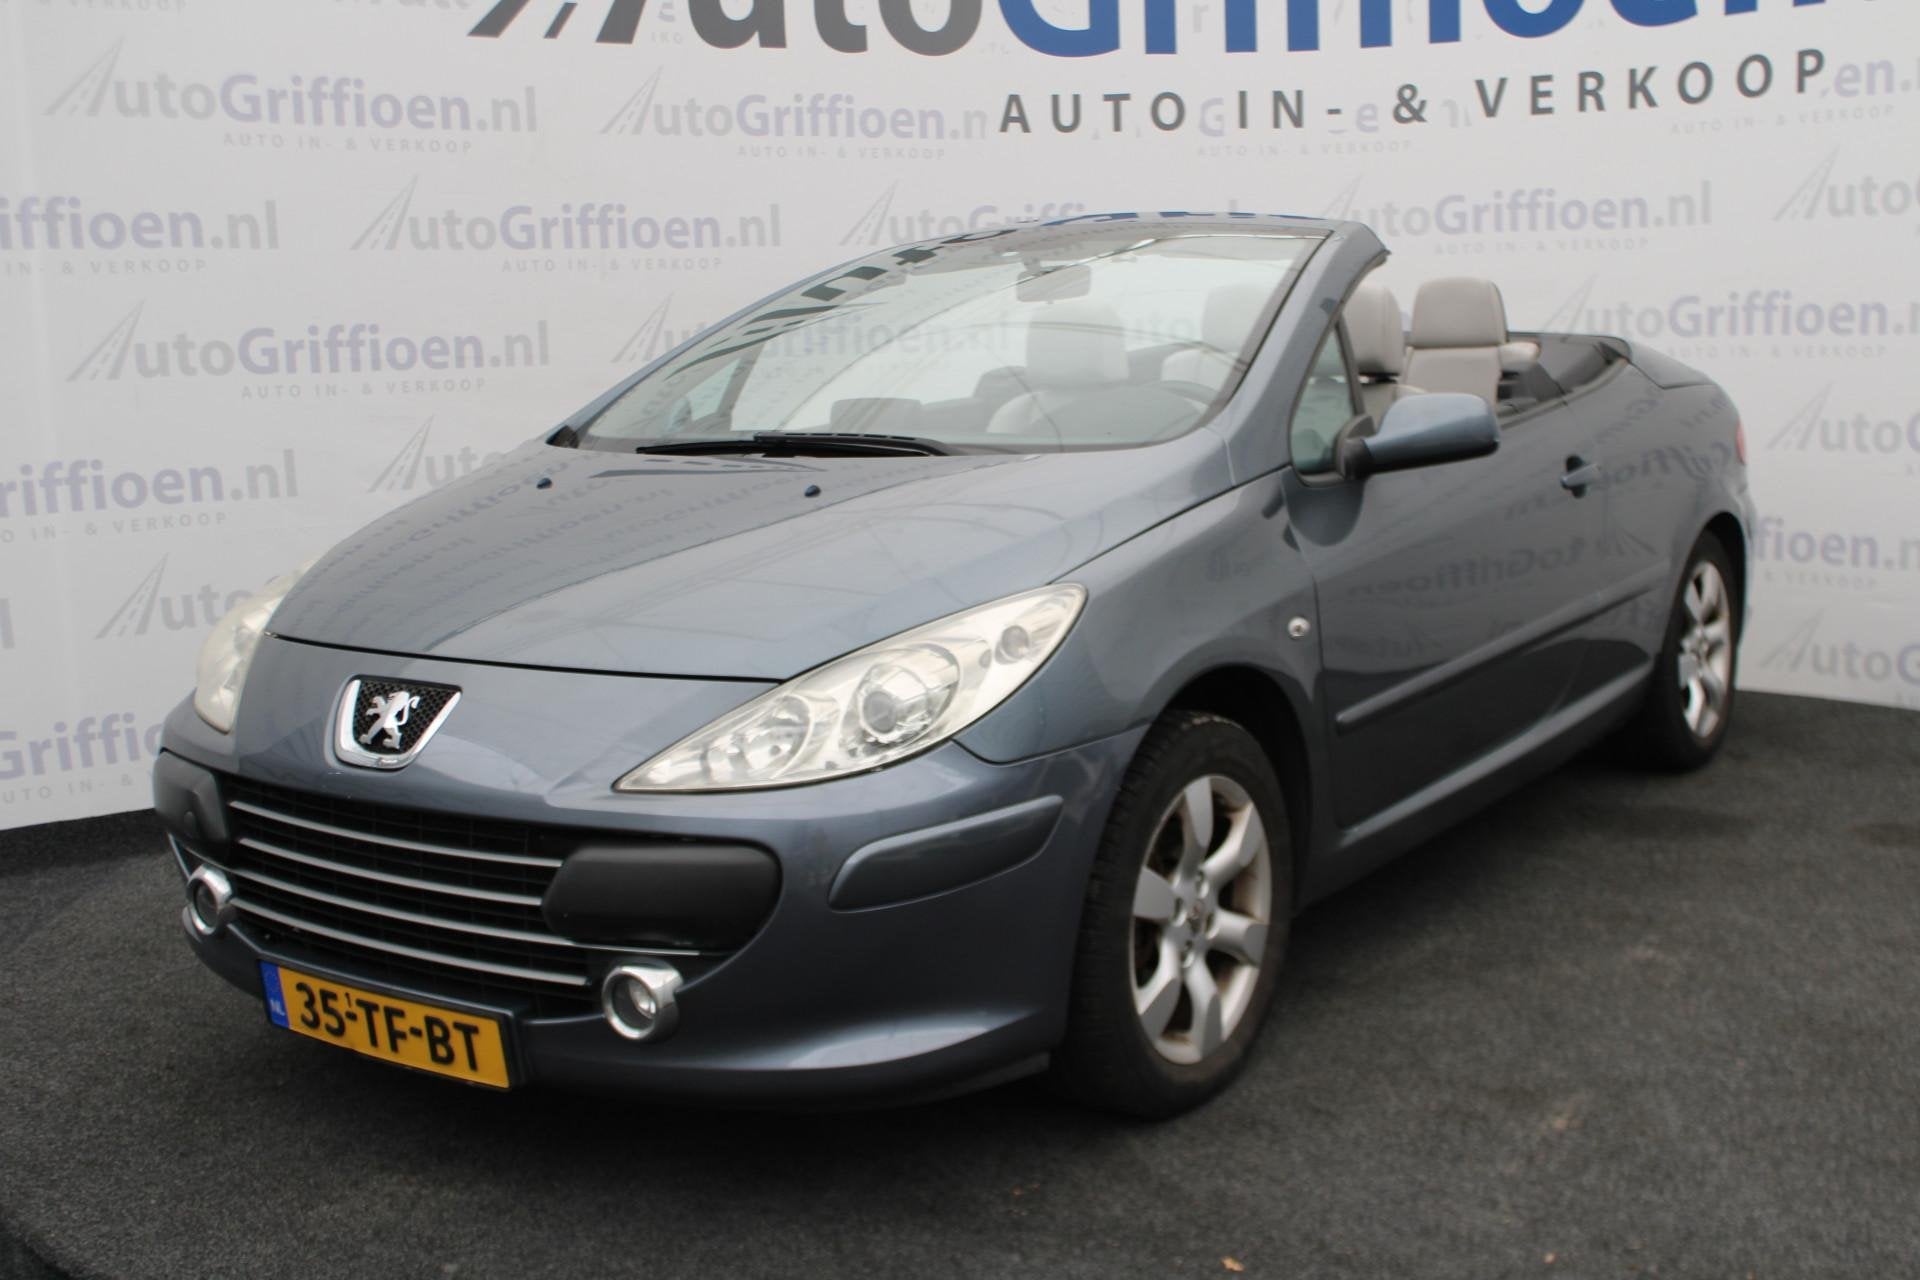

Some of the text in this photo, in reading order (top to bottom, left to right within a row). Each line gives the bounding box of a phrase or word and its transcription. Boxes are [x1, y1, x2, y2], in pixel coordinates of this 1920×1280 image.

[44, 36, 536, 132] AutoGriffioen.nl
[600, 65, 987, 140] AutoGriffioen.
[999, 91, 1186, 133] AUTO
[1392, 83, 1427, 124] &
[1475, 48, 1826, 118] VERKOOP
[223, 132, 284, 148] AUTO
[346, 136, 357, 151] &
[371, 138, 472, 154] VERKOOP
[738, 145, 787, 158] AUTO
[858, 147, 945, 160] VERKOOP
[350, 174, 782, 250] AutoGriffioen.nl
[1772, 144, 1920, 221] Auto
[91, 258, 206, 275] VERKOOP
[502, 258, 554, 272] AUTO
[630, 256, 722, 271] VERKOOP
[66, 298, 550, 380] AutoGriffioen.nl
[241, 384, 300, 399] AUTO
[386, 376, 487, 394] VERKOOP
[113, 512, 227, 534] VERKOOP
[296, 982, 479, 1073] 35-TF-BT
